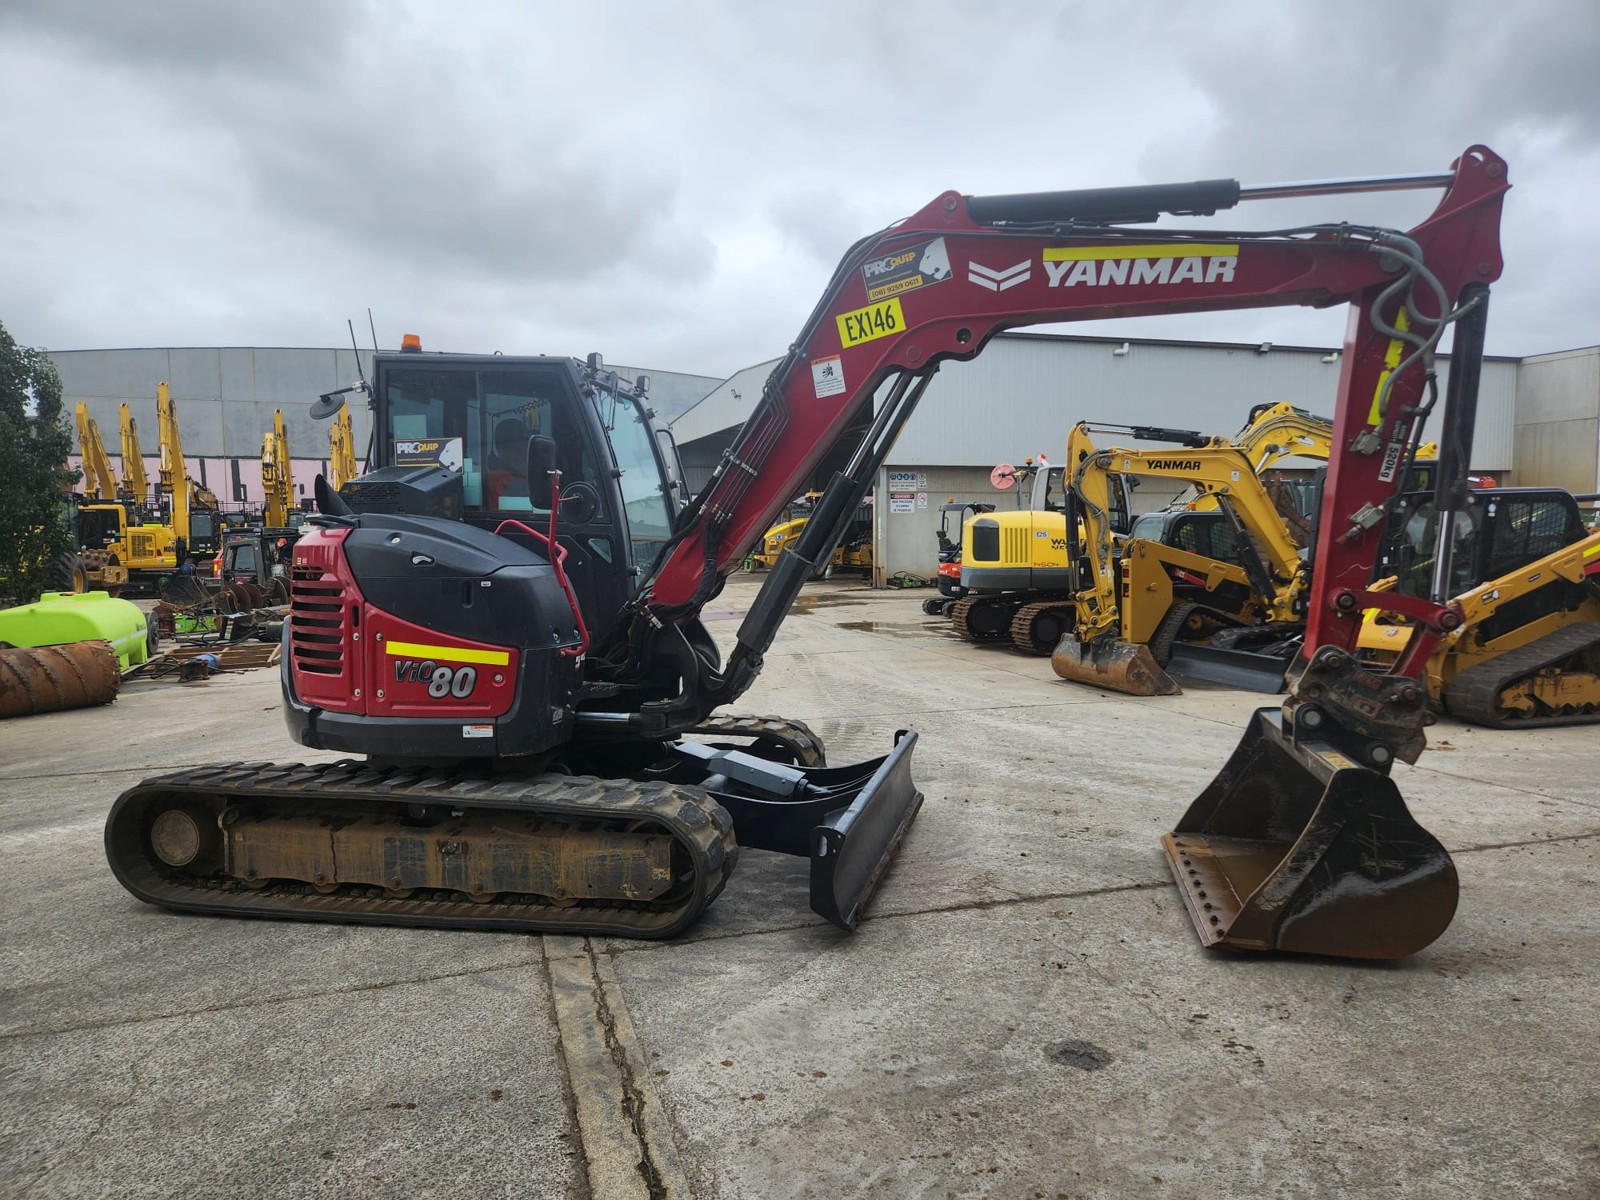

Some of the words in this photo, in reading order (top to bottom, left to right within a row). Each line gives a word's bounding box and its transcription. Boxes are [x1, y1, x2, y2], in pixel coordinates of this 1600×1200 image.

[1043, 255, 1238, 288] YANMAR
[845, 304, 896, 342] EX146
[1146, 459, 1202, 471] YANMAR
[1380, 447, 1399, 478] 520kg
